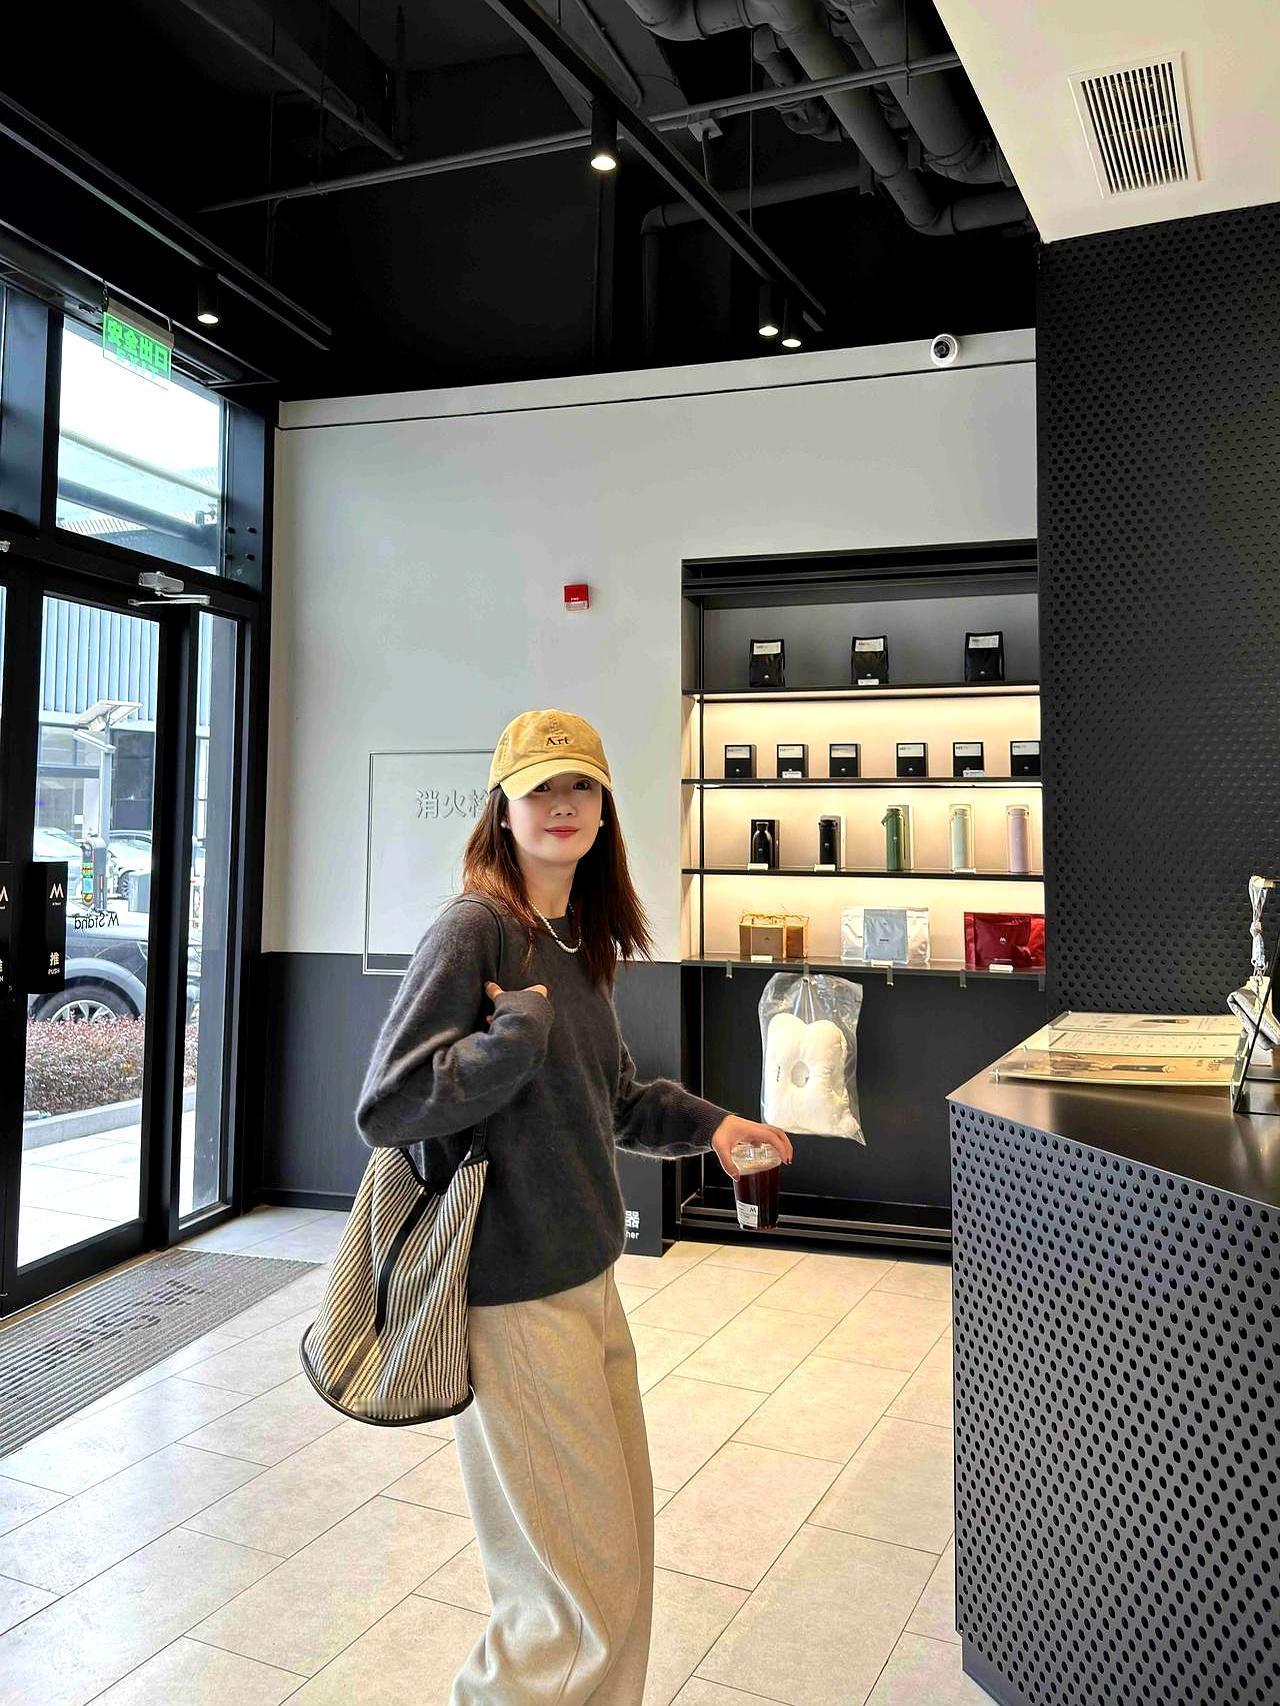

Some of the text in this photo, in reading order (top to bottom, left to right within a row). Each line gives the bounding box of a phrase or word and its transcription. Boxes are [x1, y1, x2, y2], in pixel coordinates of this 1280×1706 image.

[107, 319, 169, 373] 安全出口
[546, 736, 569, 746] Art
[49, 952, 60, 966] 推
[47, 968, 61, 976] PUSH
